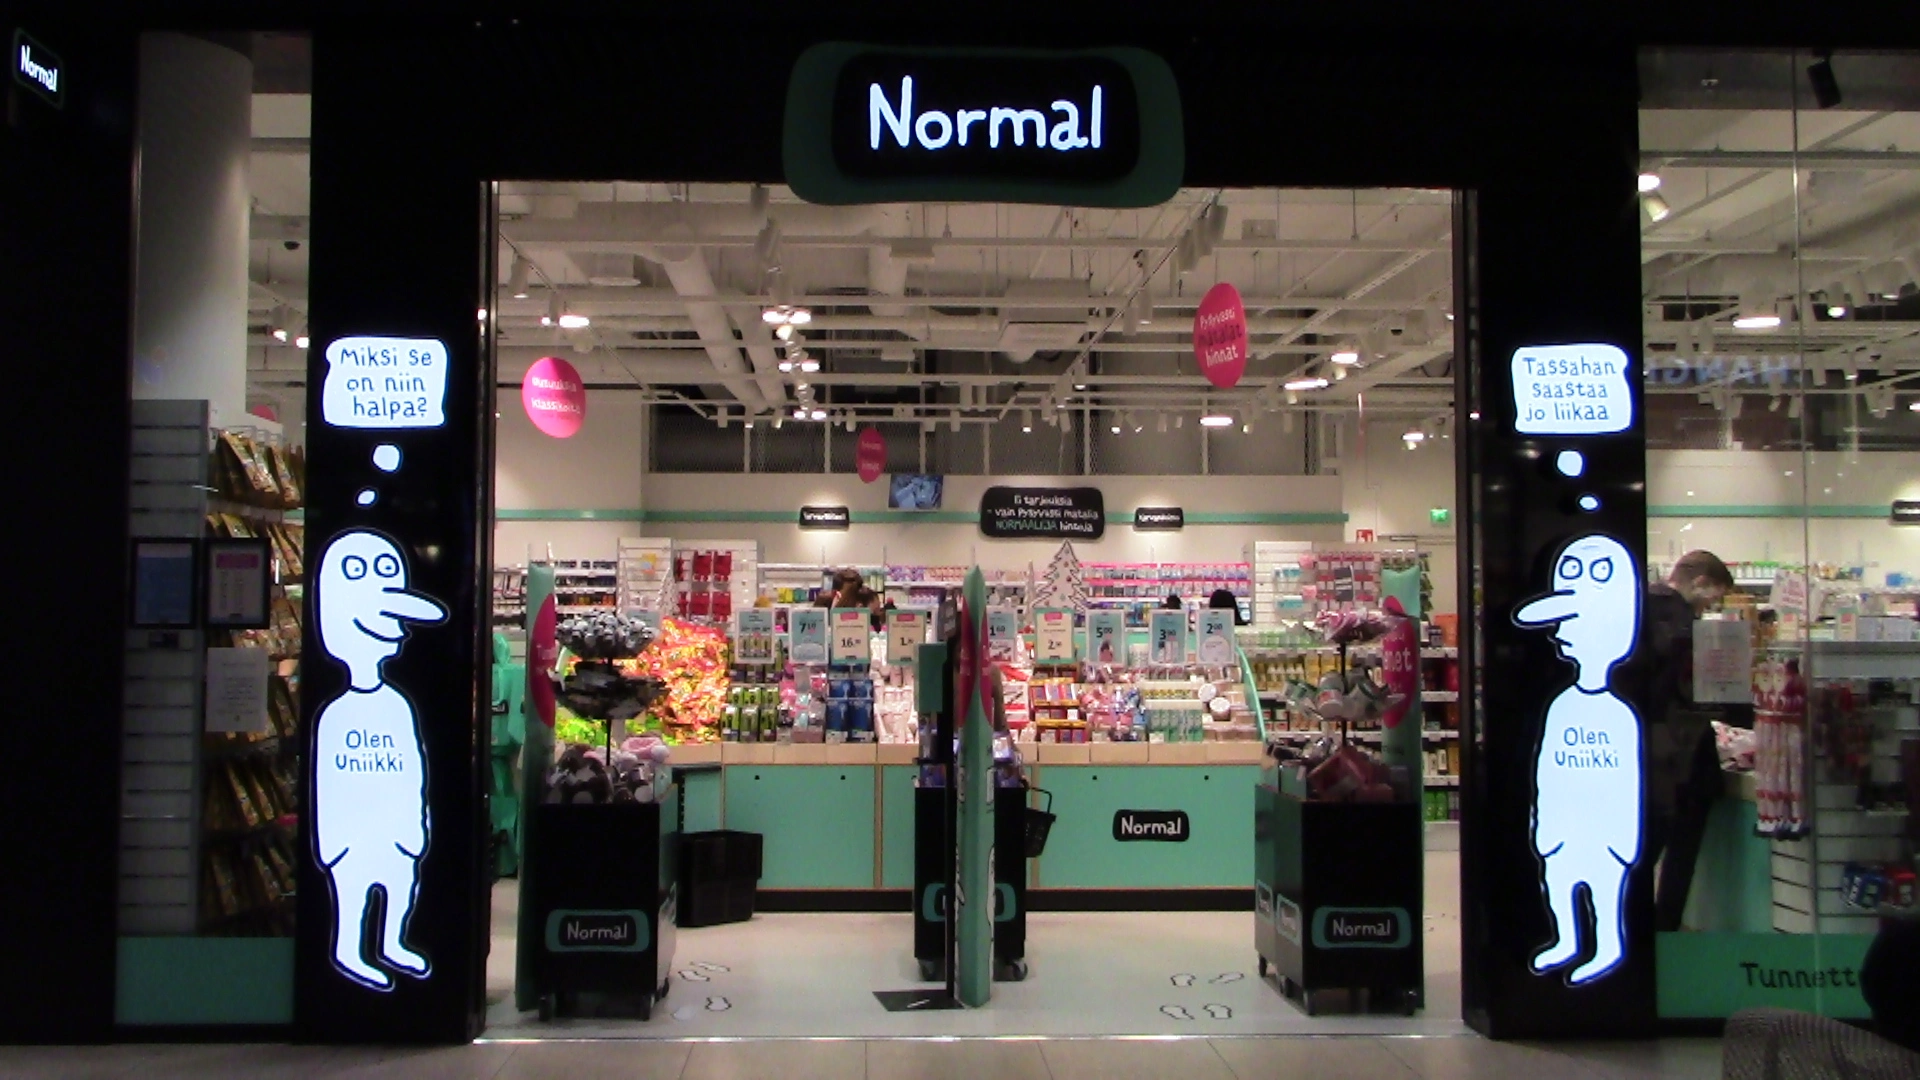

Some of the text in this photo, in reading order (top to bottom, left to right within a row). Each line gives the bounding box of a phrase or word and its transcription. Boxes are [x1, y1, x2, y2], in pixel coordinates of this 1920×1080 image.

[21, 45, 57, 92] Normal
[869, 75, 1102, 150] Normal
[340, 345, 398, 367] Miksi
[1205, 344, 1239, 368] hinnat
[346, 372, 426, 392] on niin
[353, 395, 428, 420] halpa?
[1525, 402, 1609, 422] jo liikaa
[995, 507, 1016, 516] vain
[1063, 509, 1099, 519] matalia
[1060, 521, 1094, 532] hintoja
[345, 729, 395, 750] Olen
[1563, 726, 1610, 746] Olen
[335, 752, 403, 772] Uniikki
[1554, 749, 1619, 768] Uniikki
[1120, 815, 1182, 835] Normal
[566, 921, 628, 941] Normal
[1332, 917, 1391, 937] Normal
[1739, 961, 1862, 988] Tunnett
